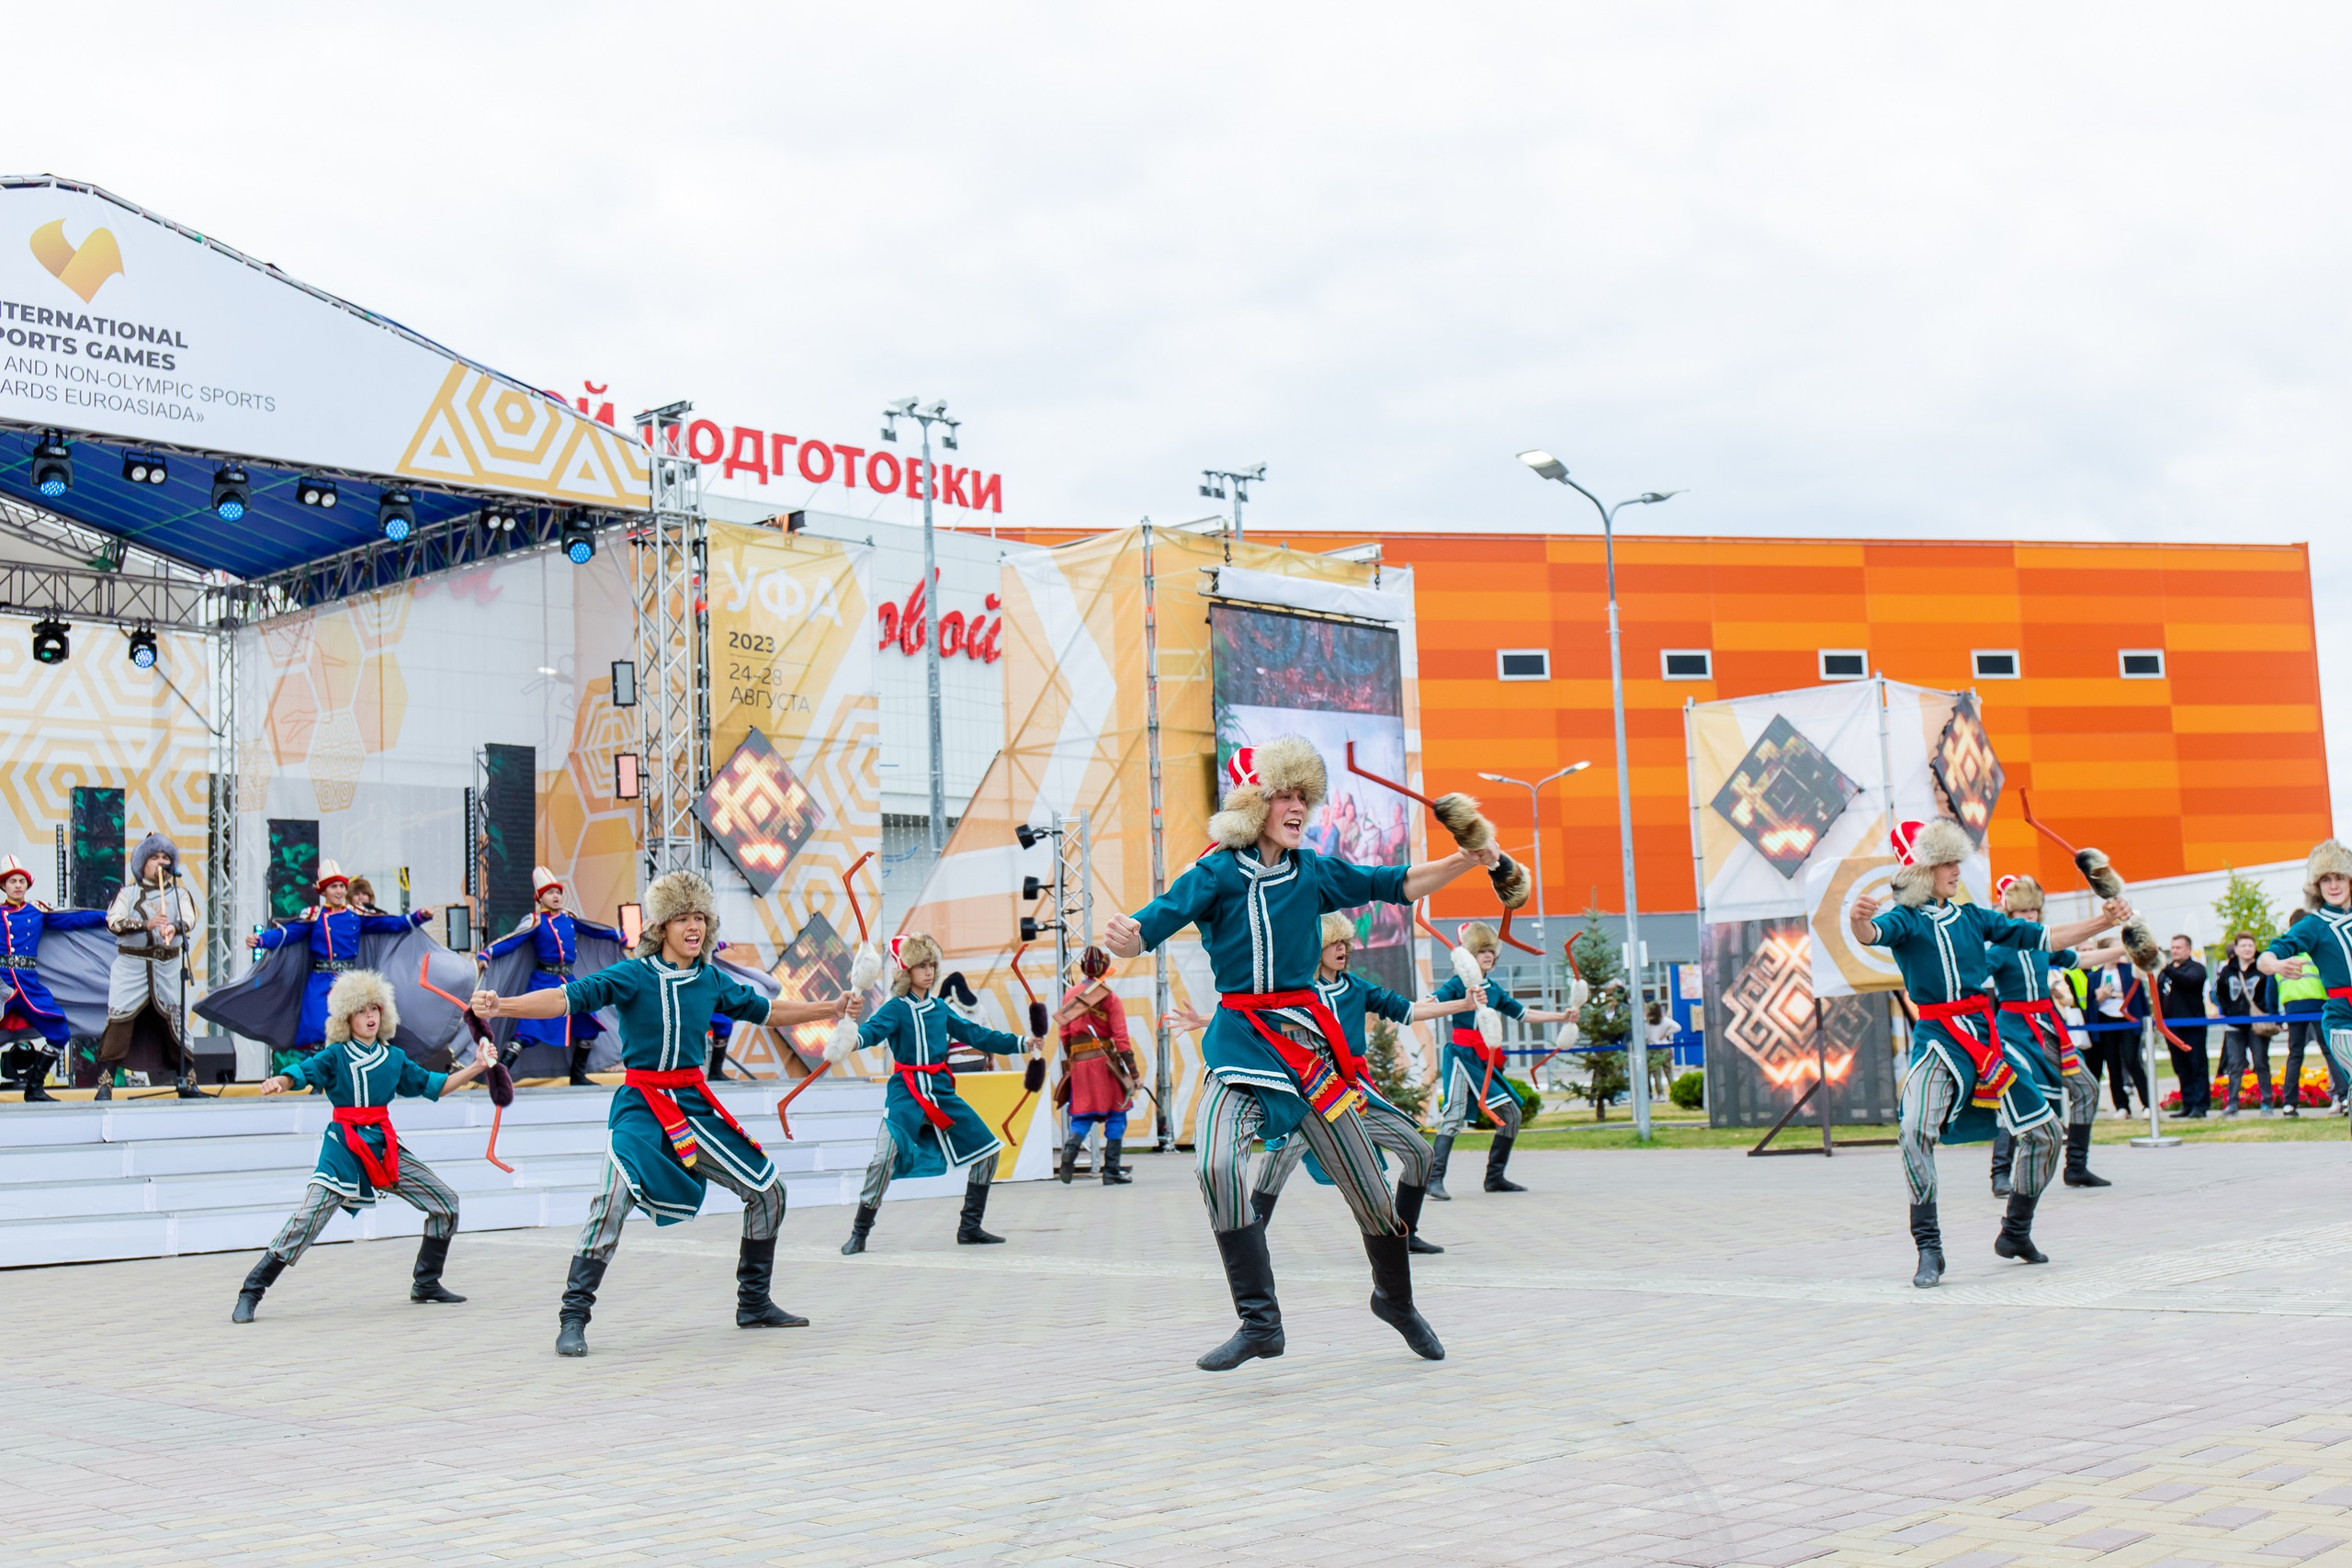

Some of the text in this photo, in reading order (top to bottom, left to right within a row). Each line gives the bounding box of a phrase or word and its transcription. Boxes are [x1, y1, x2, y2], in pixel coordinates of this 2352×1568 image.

[0, 300, 188, 349] TERNATIONAL
[85, 341, 175, 371] GAMES
[0, 378, 205, 423] ARDS EUROASIADA»
[4, 355, 276, 412] AND NON-OLYMPIC SPORTS
[723, 560, 843, 626] УФА
[729, 632, 775, 653] 2023
[729, 687, 810, 713] АВГУСТА
